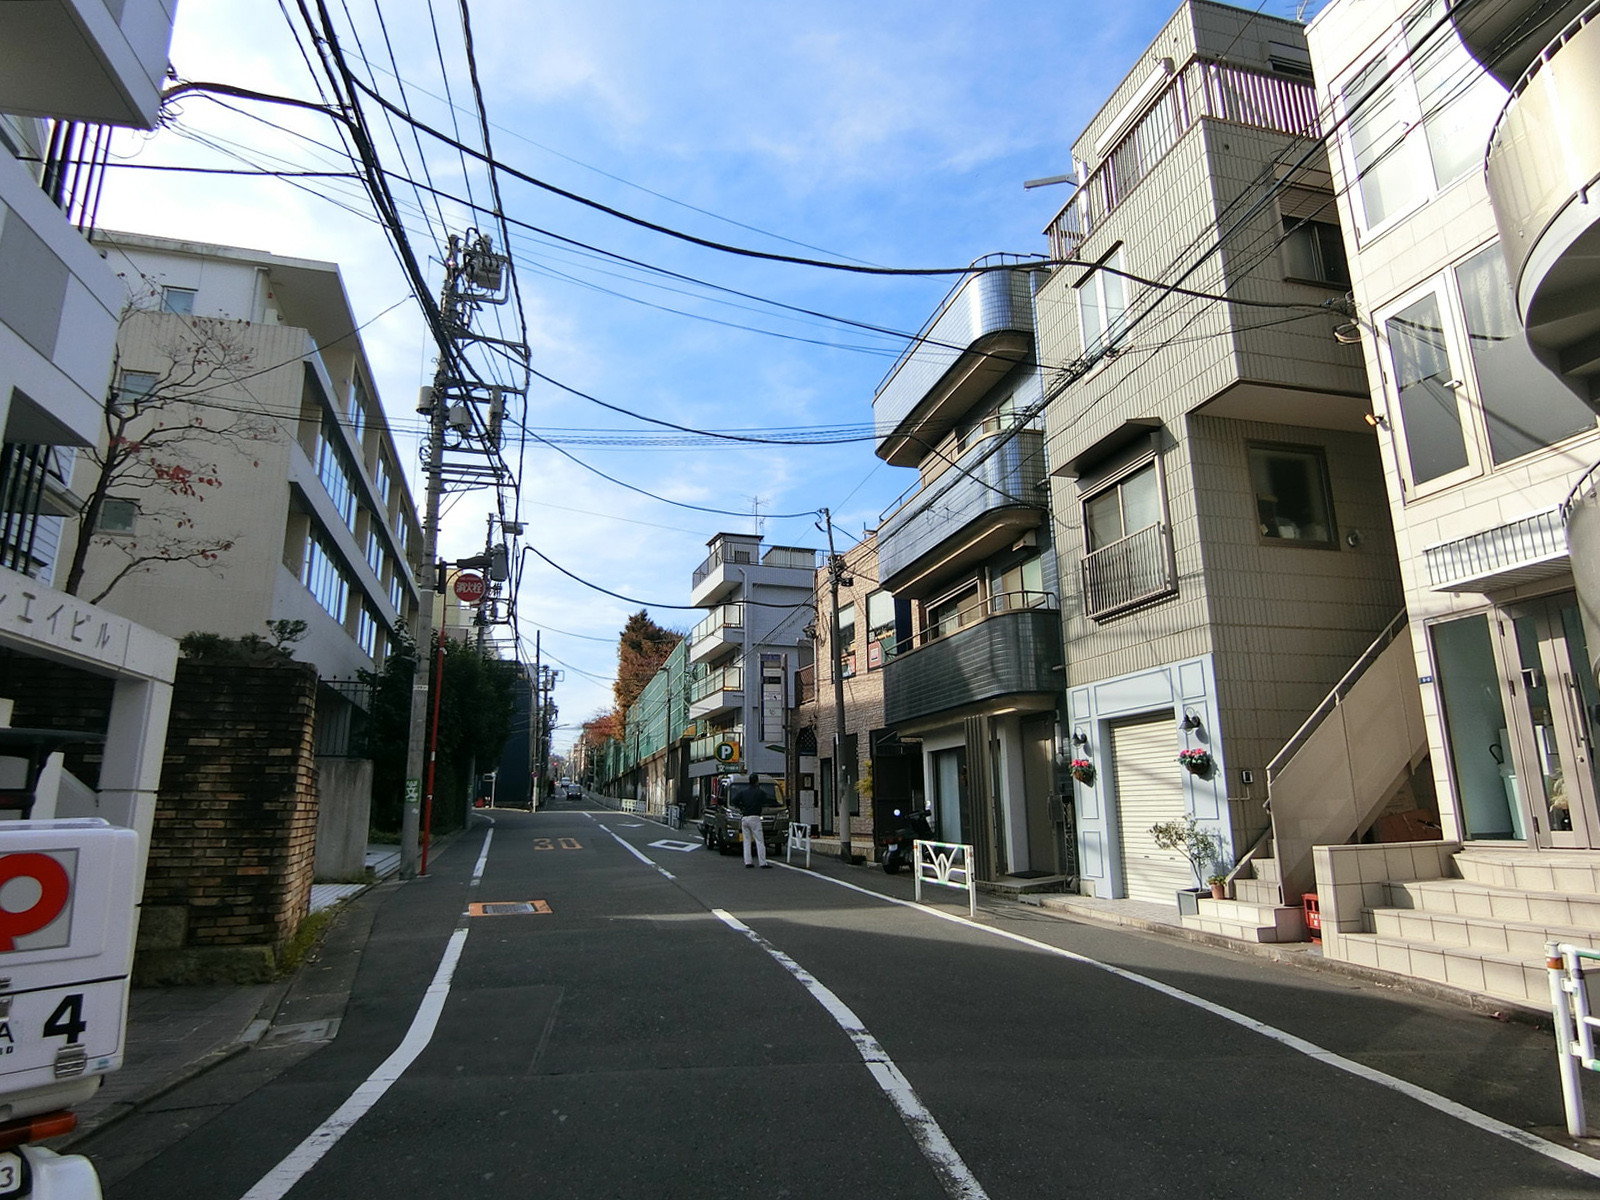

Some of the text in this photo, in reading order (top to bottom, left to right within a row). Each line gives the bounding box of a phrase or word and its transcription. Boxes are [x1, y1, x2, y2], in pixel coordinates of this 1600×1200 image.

[456, 582, 482, 593] 消火栓
[0, 592, 110, 649] エイビル
[721, 745, 732, 759] P
[533, 837, 583, 850] 30
[42, 993, 87, 1044] 4
